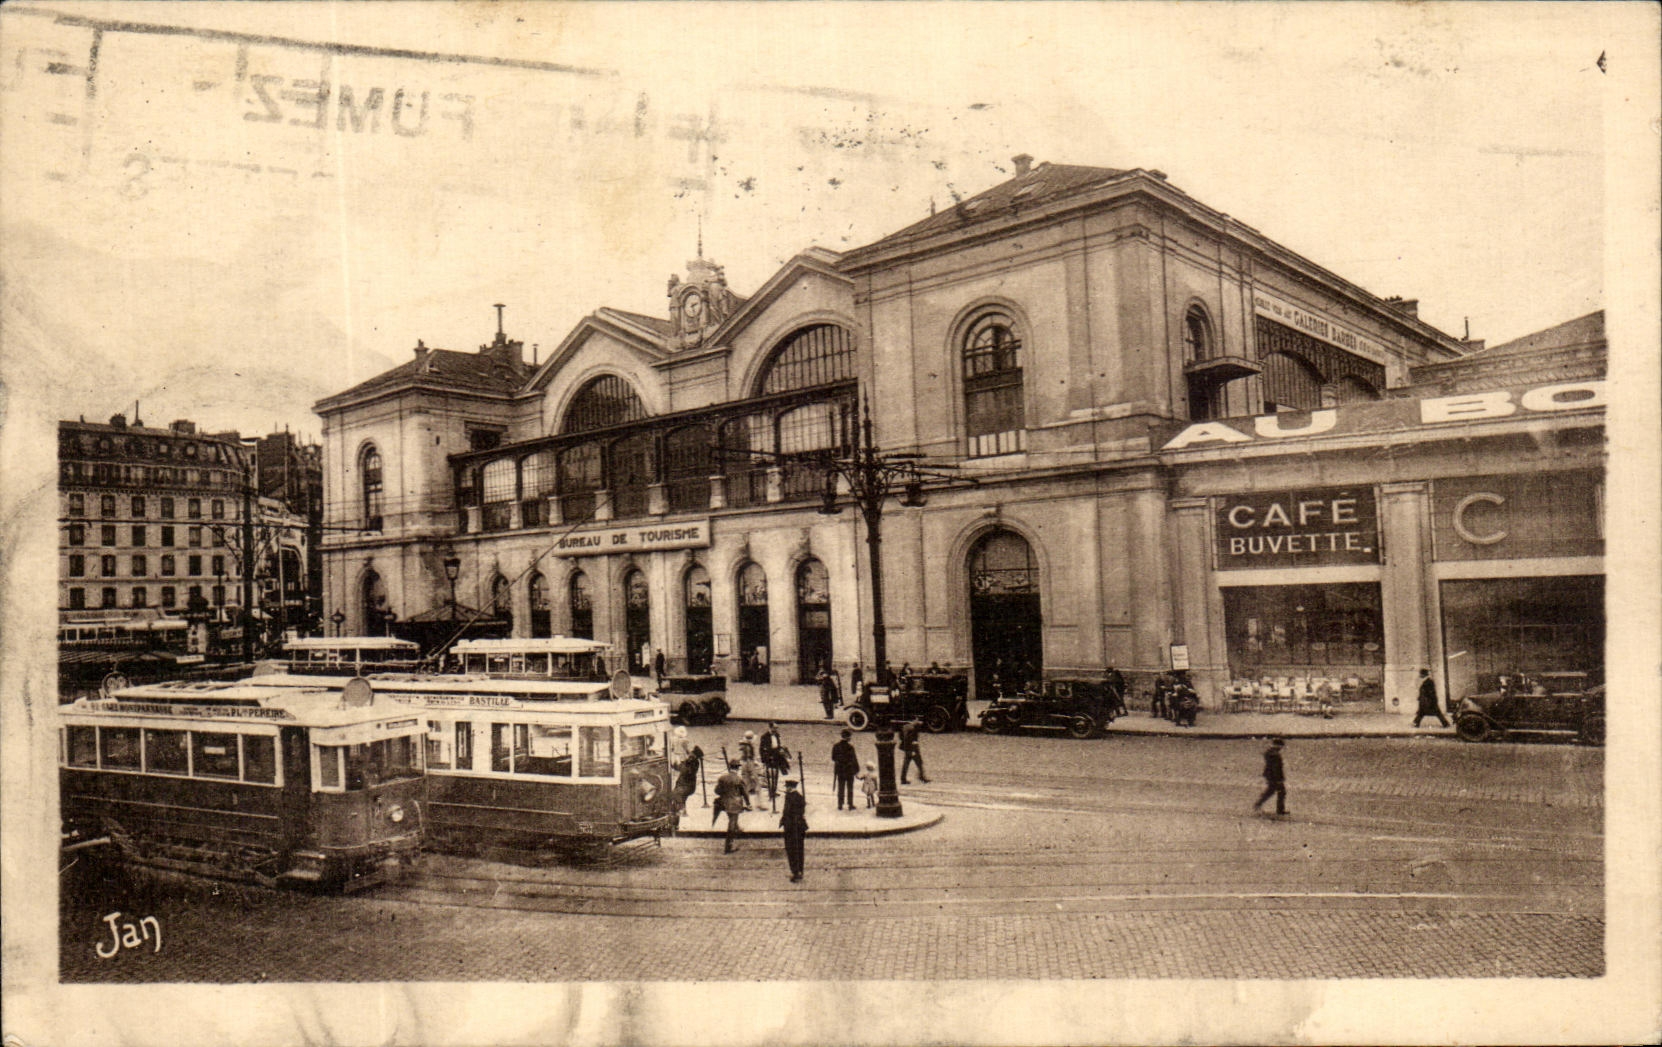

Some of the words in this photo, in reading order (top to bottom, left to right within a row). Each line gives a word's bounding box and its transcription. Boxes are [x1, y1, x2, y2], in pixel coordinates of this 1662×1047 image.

[1161, 409, 1336, 449] AU
[1228, 492, 1358, 529] CAFÉ
[559, 535, 601, 549] BUREAU
[612, 533, 627, 545] DE
[639, 527, 700, 543] TOURISME
[469, 696, 510, 706] BASTILLE
